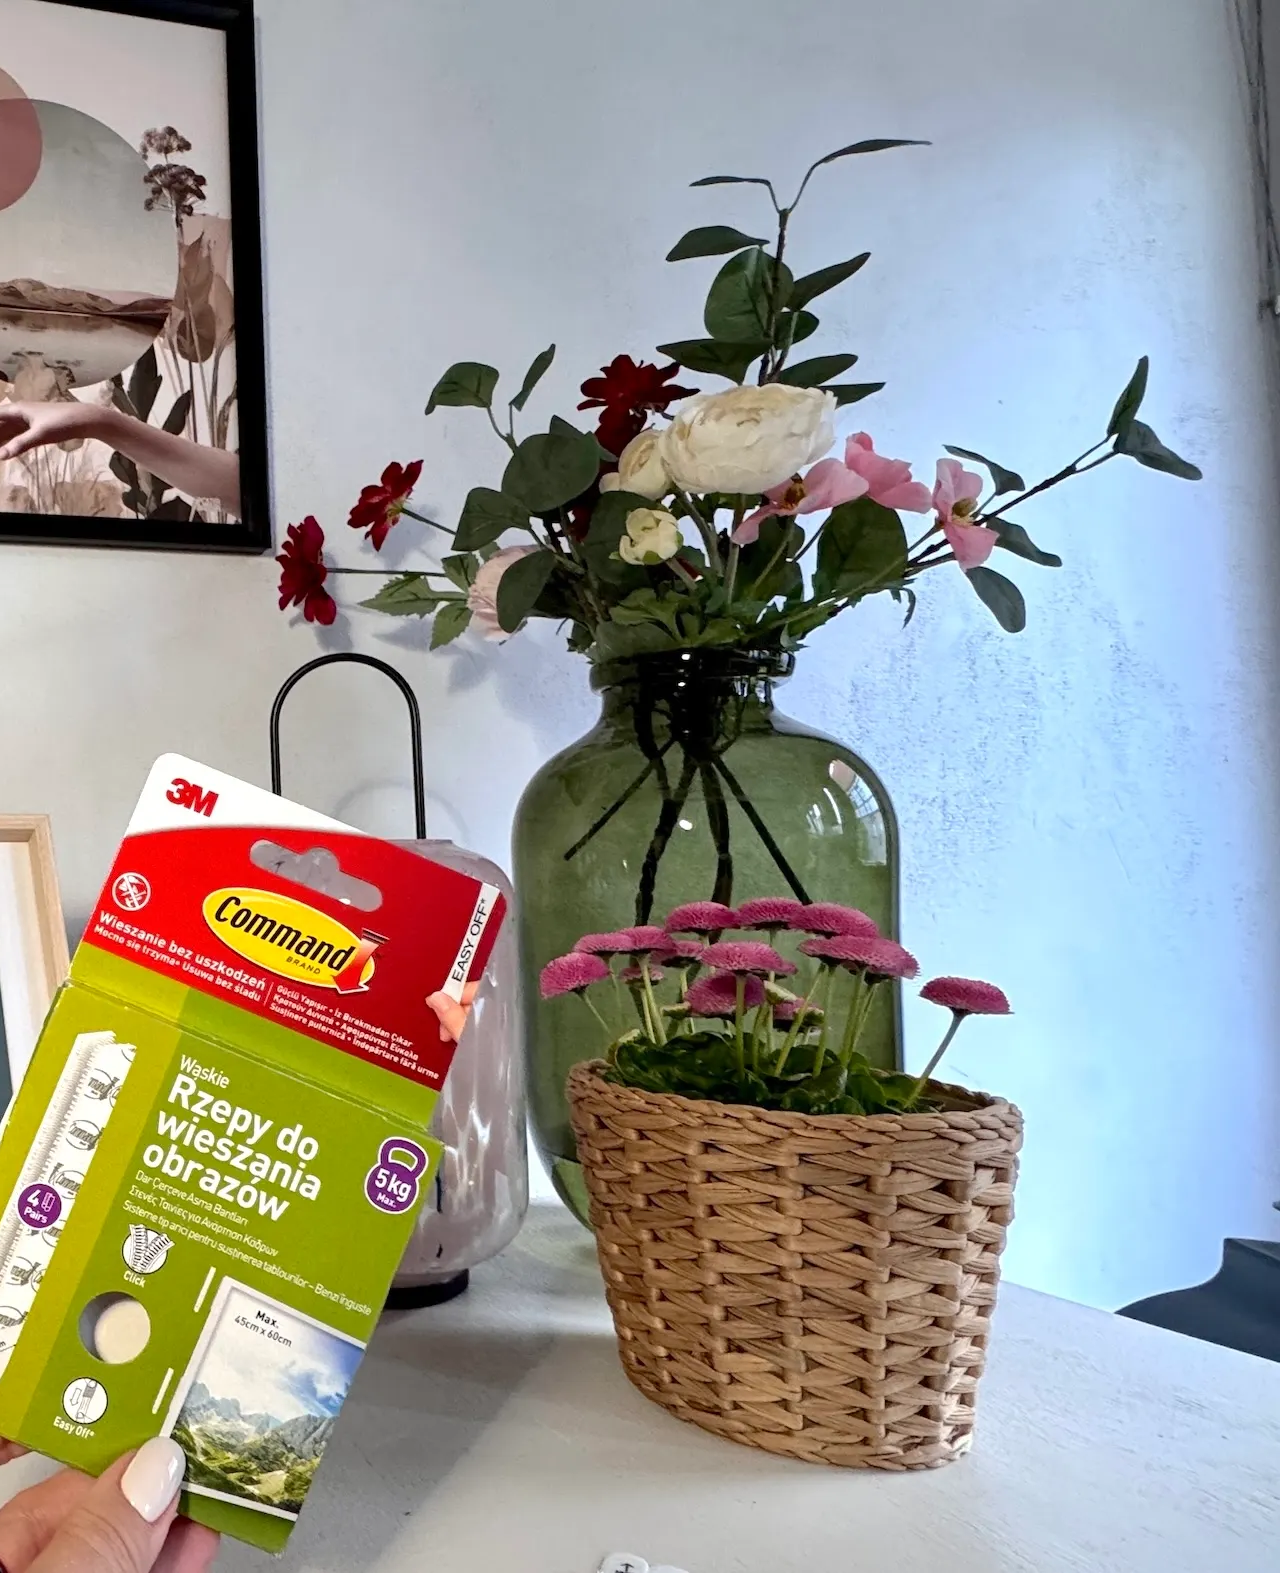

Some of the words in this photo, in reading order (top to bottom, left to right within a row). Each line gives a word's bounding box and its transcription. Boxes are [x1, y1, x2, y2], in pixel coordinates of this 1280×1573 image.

[166, 778, 219, 817] 3M
[99, 910, 167, 948] Wieszanie
[168, 940, 194, 960] bez
[195, 954, 266, 991] uszkodzeń
[215, 896, 356, 971] Command
[94, 925, 125, 944] Mocno
[126, 938, 141, 951] się
[182, 962, 214, 983] Usuwa
[215, 977, 232, 991] bez
[234, 981, 261, 1002] śladu
[286, 956, 321, 975] BRAND
[451, 939, 475, 982] EASY
[276, 984, 300, 1001] Güçlü
[300, 995, 327, 1014] Yapışır
[343, 1012, 391, 1039] Bırakmadan
[391, 1032, 413, 1048] Çıkar
[307, 1018, 346, 1041] puternică
[400, 1056, 417, 1070] fără
[417, 1065, 439, 1080] urme
[180, 1054, 230, 1089] Wąskie
[167, 1073, 274, 1145] Rzepy
[276, 1124, 319, 1161] do
[157, 1110, 322, 1201] wieszania
[27, 1189, 41, 1207] 4
[135, 1170, 152, 1184] Dar
[152, 1177, 188, 1200] Çerçeve
[186, 1192, 213, 1212] Asma
[143, 1143, 290, 1222] obrazów
[376, 1192, 397, 1208] Max.
[23, 1206, 48, 1224] Pairs
[122, 1200, 158, 1223] Sisteme
[157, 1213, 169, 1228] tip
[168, 1220, 188, 1236] arici
[187, 1229, 218, 1249] pentru
[263, 1260, 309, 1289] tablourilor
[123, 1270, 146, 1288] Click
[234, 1315, 260, 1333] 45cm
[260, 1327, 266, 1336] x
[267, 1329, 292, 1348] 60cm
[255, 1310, 279, 1329] Max.
[53, 1416, 75, 1435] Easy
